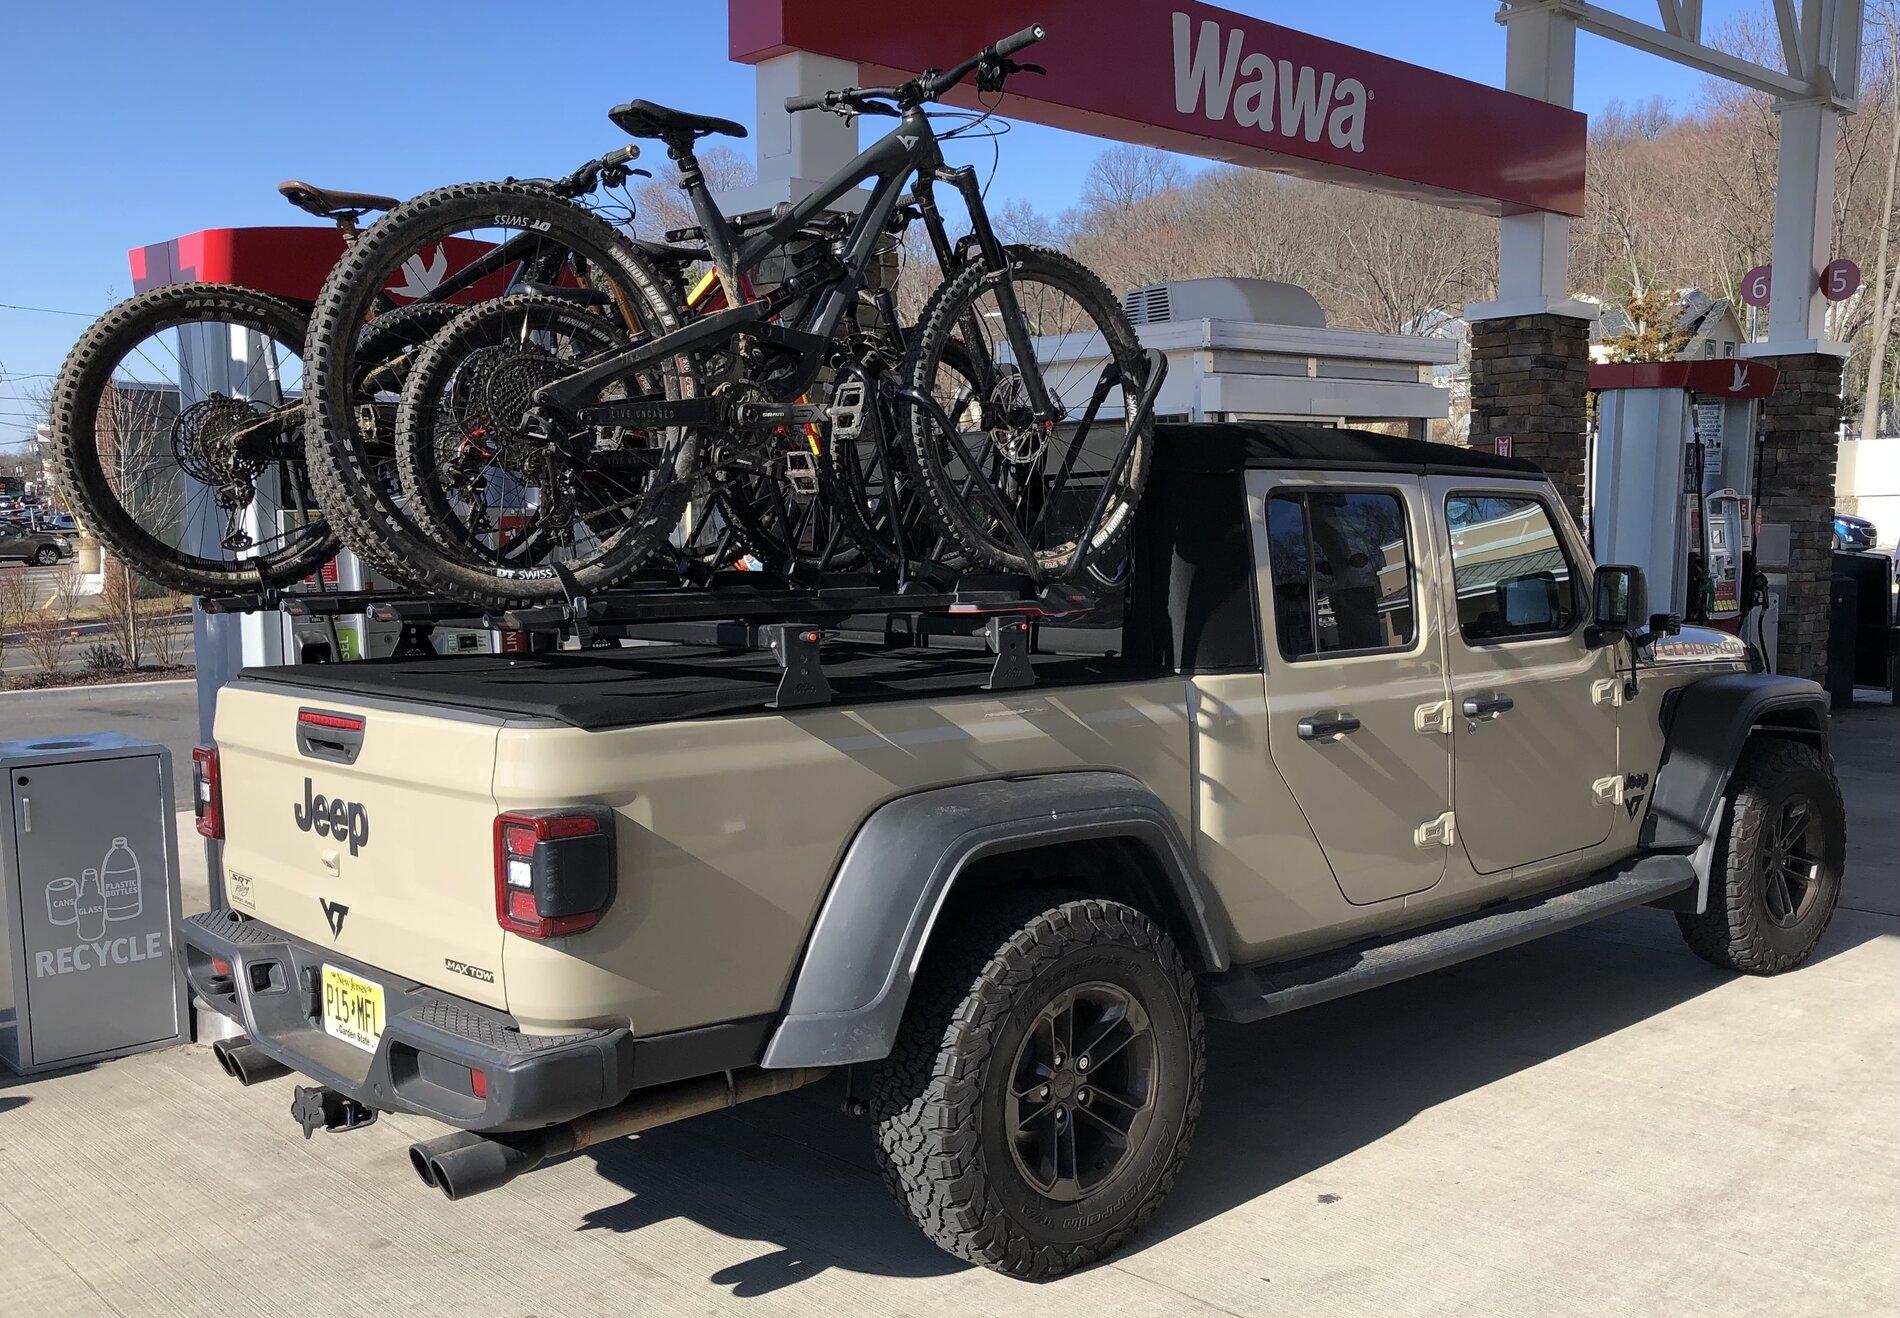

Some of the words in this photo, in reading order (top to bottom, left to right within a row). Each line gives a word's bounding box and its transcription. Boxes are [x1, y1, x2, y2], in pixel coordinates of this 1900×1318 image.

[1172, 12, 1367, 152] Wawa
[493, 214, 529, 228] SWISS
[530, 219, 551, 232] DT
[608, 247, 650, 288] MINION
[1752, 276, 1767, 299] 6
[1831, 269, 1848, 293] 5
[185, 299, 267, 316] MAXXIS
[343, 438, 403, 532] MAXXIS
[496, 568, 516, 580] DT
[519, 569, 553, 580] SWISS
[294, 776, 370, 858] Jeep
[105, 879, 138, 891] PLASTIC
[232, 873, 251, 886] SRT
[53, 898, 74, 908] CANS
[105, 886, 138, 898] BOTTLES
[78, 905, 103, 916] GLASS
[35, 932, 163, 978] RECYCLE
[446, 959, 469, 976] MAX
[468, 966, 493, 982] TOW
[326, 983, 350, 1024] P15
[356, 994, 381, 1039] MFL
[338, 1024, 357, 1040] Garden
[356, 1031, 371, 1047] State
